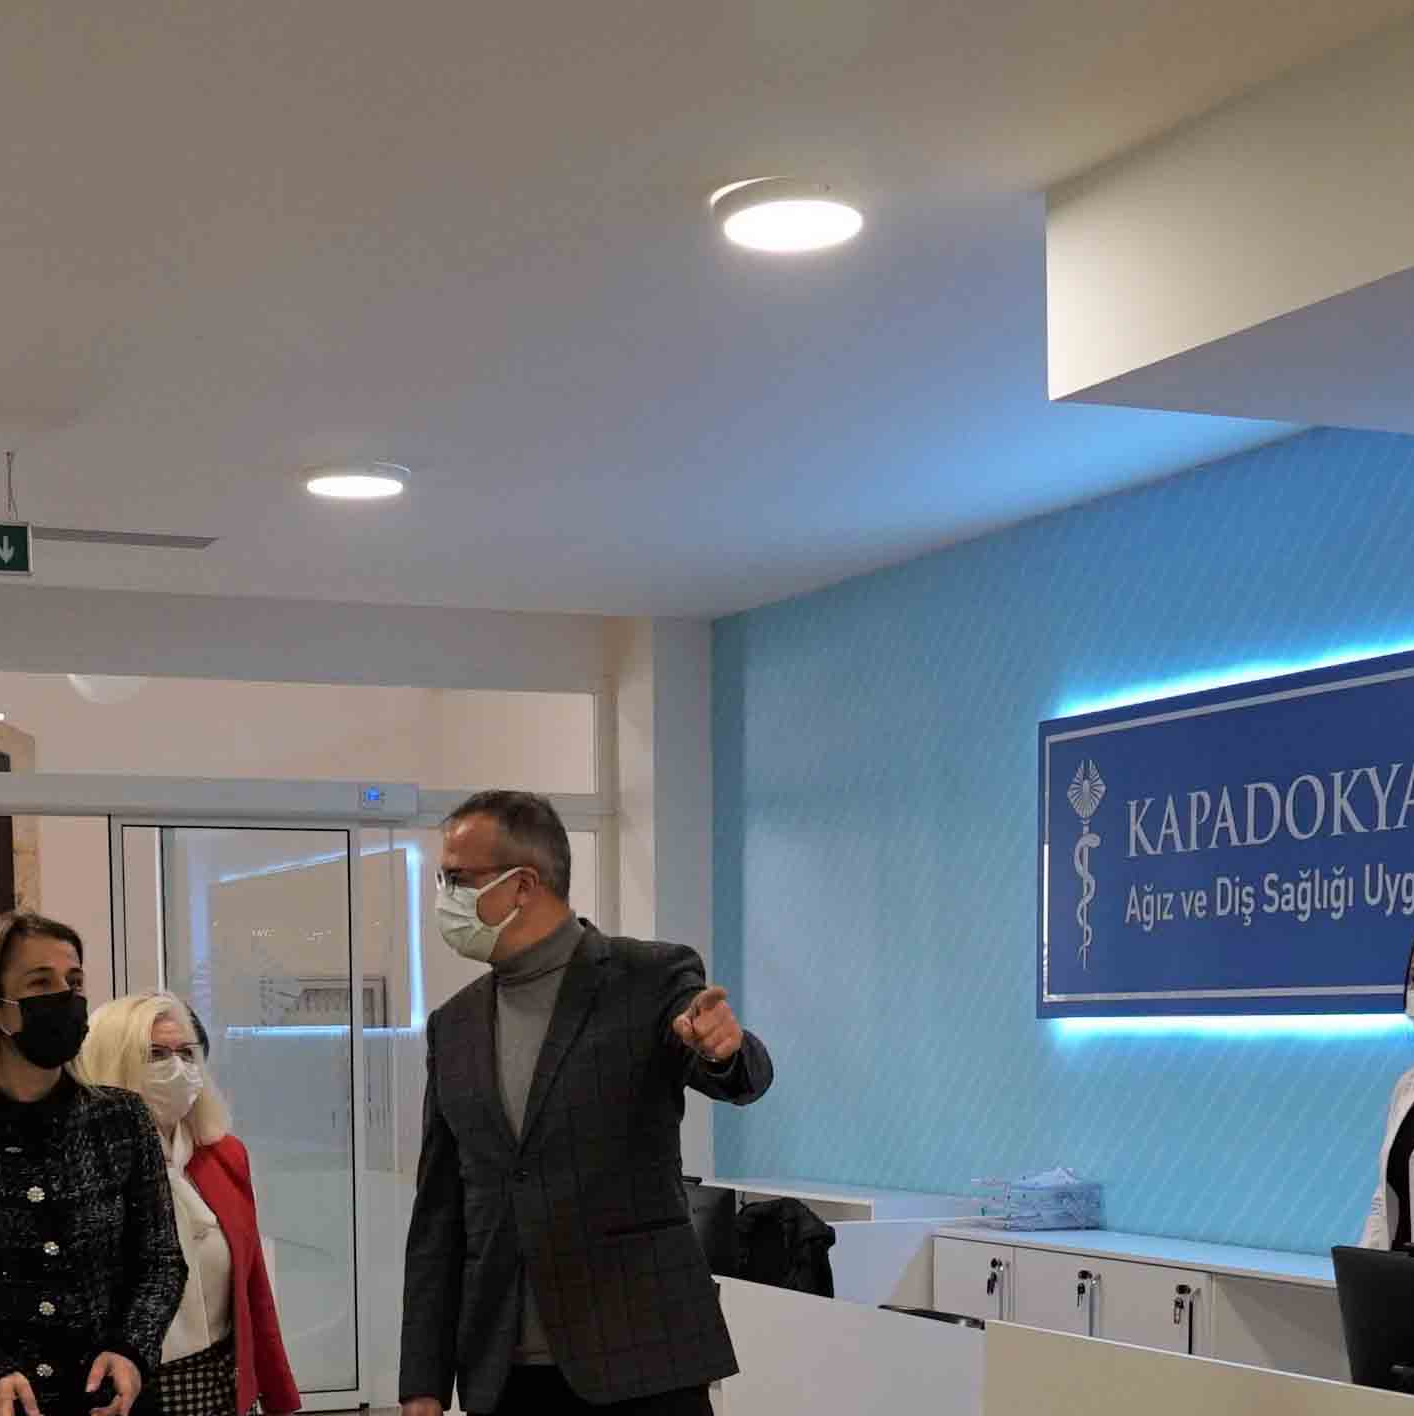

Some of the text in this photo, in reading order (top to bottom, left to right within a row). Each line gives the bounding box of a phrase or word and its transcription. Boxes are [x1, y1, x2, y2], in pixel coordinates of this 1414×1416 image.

[1124, 882, 1174, 932] Ağız
[1180, 889, 1207, 919] ve
[1215, 875, 1255, 927] Diş
[1261, 865, 1354, 922] Sağlığı
